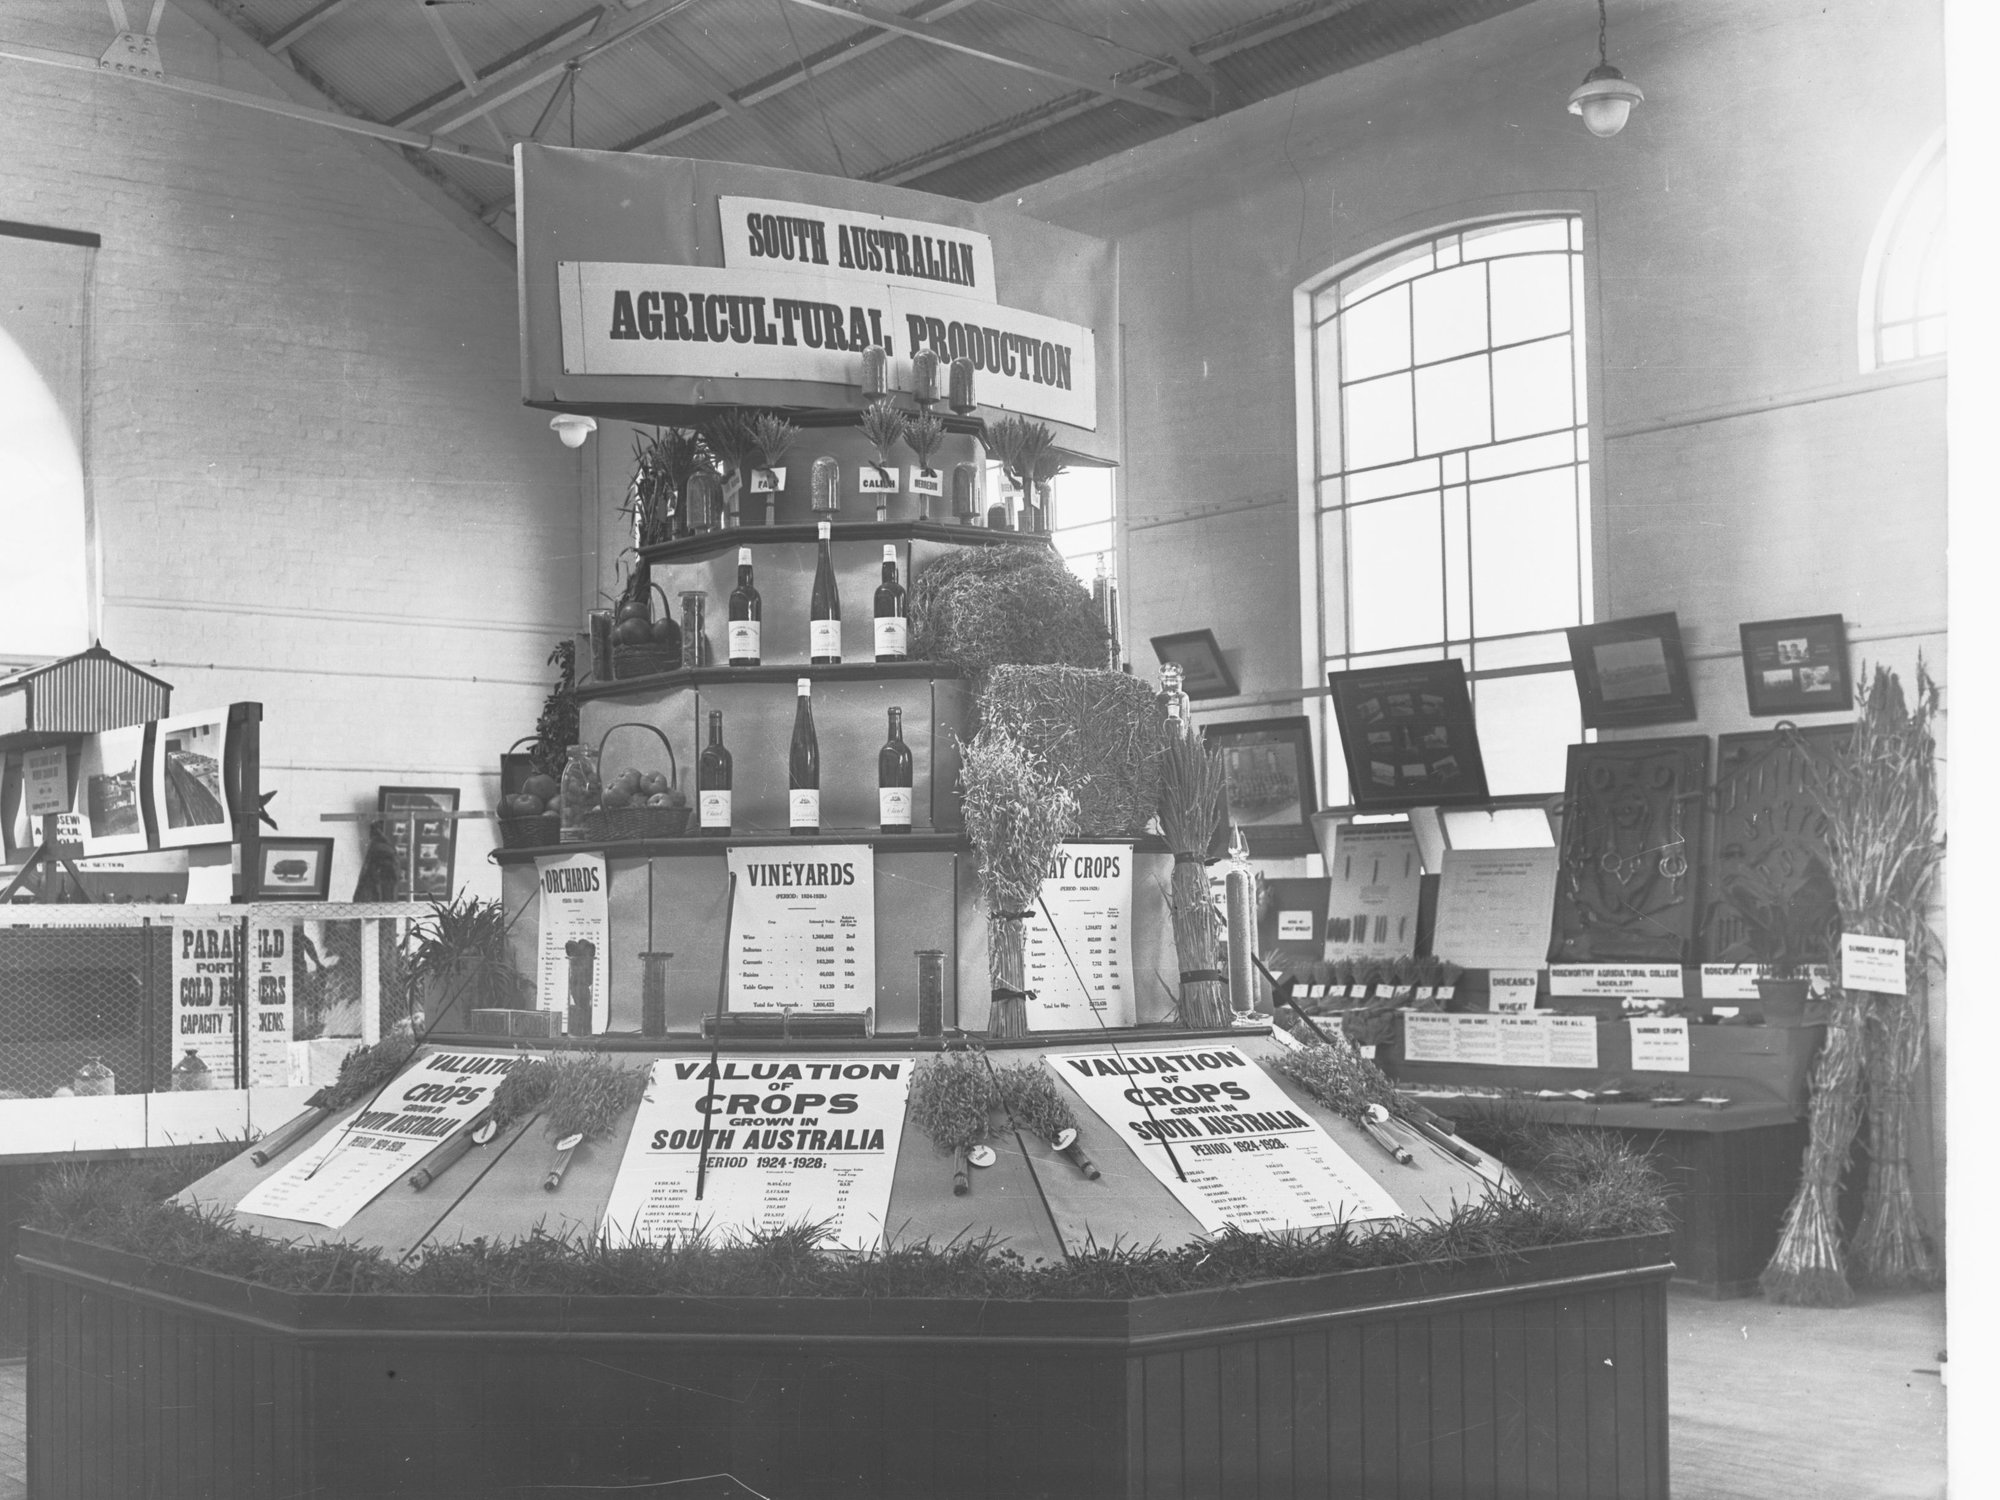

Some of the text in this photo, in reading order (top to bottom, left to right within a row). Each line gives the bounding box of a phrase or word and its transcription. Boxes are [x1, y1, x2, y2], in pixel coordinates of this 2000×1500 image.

[747, 212, 976, 288] SOUTH AUSTRALIAN
[610, 290, 1073, 391] AGRICULTURAL PRODUCTION
[863, 479, 895, 488] CALIH
[747, 862, 855, 887] VINEYARDS
[1045, 856, 1120, 879] AY CROPS
[545, 866, 600, 894] ORCHARDS
[1878, 946, 1899, 956] CROPS
[1492, 977, 1536, 986] DISEASES
[1552, 968, 1679, 978] ROSEWORTHY AGRICULTURAL COLLEGE
[180, 977, 213, 1007] COLD
[1498, 1003, 1527, 1011] WHEAT
[180, 1014, 223, 1035] CAPACITY
[674, 1063, 900, 1080] VALUATION
[1067, 1050, 1246, 1078] VALUATION
[455, 1076, 471, 1084] OF
[768, 1082, 793, 1092] OF
[1161, 1075, 1180, 1084] OF
[403, 1083, 487, 1106] CROPS
[1123, 1081, 1251, 1107] CROPS
[403, 1104, 447, 1114] GROWN IN
[695, 1093, 859, 1115] CROPS
[1170, 1103, 1238, 1116] GROWN IN
[382, 1114, 462, 1138] AUSTRALIA
[729, 1117, 818, 1127] GROWN IN
[1128, 1109, 1310, 1141] SOUTH AUSTRALIA
[651, 1129, 885, 1151] SOUTH AUSTRALIA
[1190, 1142, 1232, 1157] PERIOD
[756, 1157, 827, 1169] 1924-1928:
